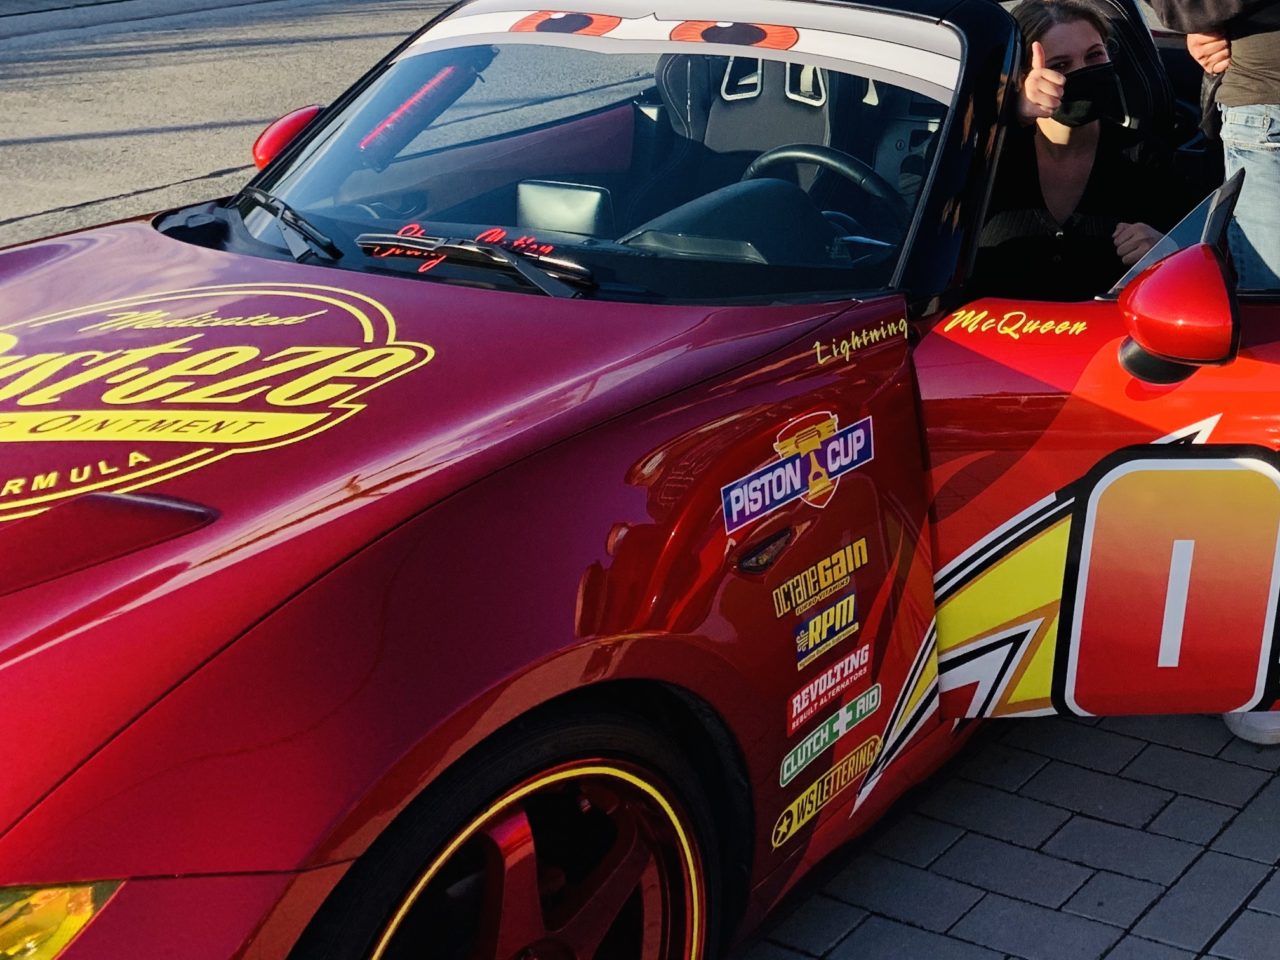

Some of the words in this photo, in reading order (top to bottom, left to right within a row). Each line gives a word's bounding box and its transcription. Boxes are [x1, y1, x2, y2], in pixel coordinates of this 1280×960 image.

[79, 309, 328, 332] Medicated
[812, 317, 909, 365] Lightning
[943, 309, 1088, 340] McQueen
[730, 458, 801, 523] PISTON
[827, 428, 865, 472] CUP
[808, 594, 855, 650] RPM
[791, 702, 818, 731] REBUILT
[819, 666, 867, 707] ALTERNATORS
[792, 643, 870, 719] REVOLTING
[783, 724, 829, 781] CLUTCH
[856, 688, 878, 719] AID
